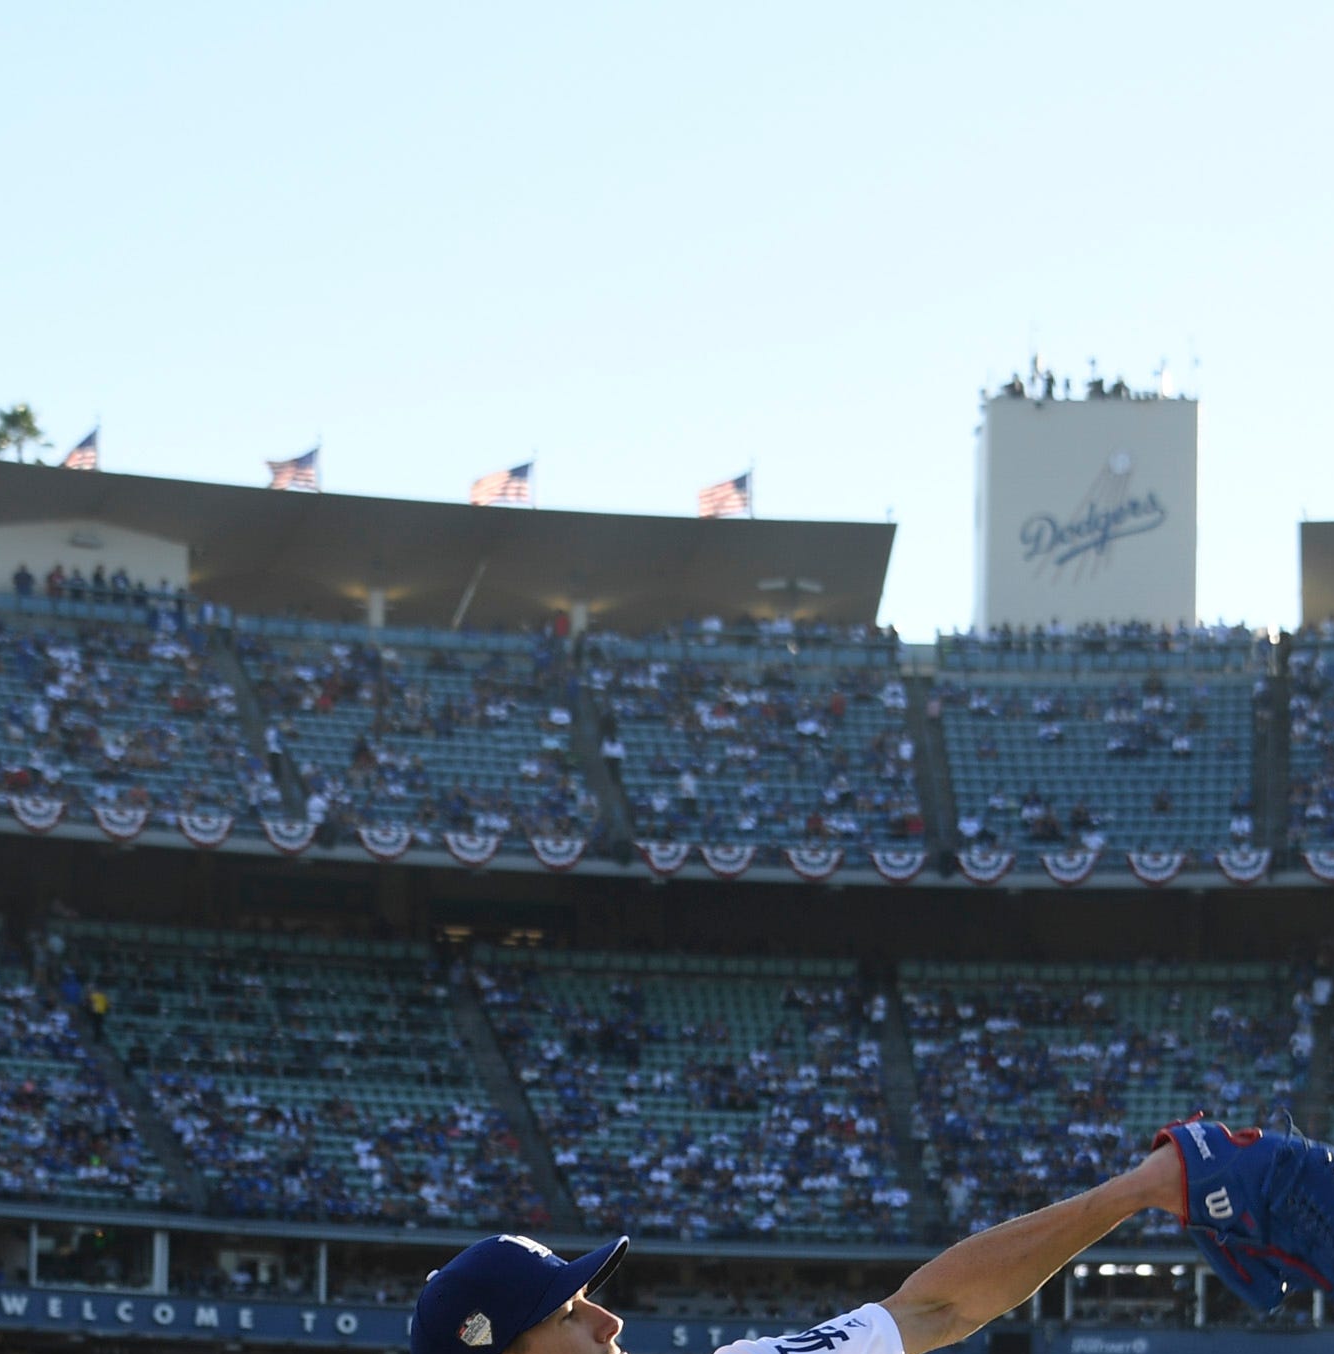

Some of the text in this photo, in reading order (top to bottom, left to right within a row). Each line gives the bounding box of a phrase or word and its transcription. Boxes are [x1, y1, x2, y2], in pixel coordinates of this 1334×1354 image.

[1020, 491, 1166, 566] Dodgers
[0, 1294, 359, 1335] WELCOME TO
